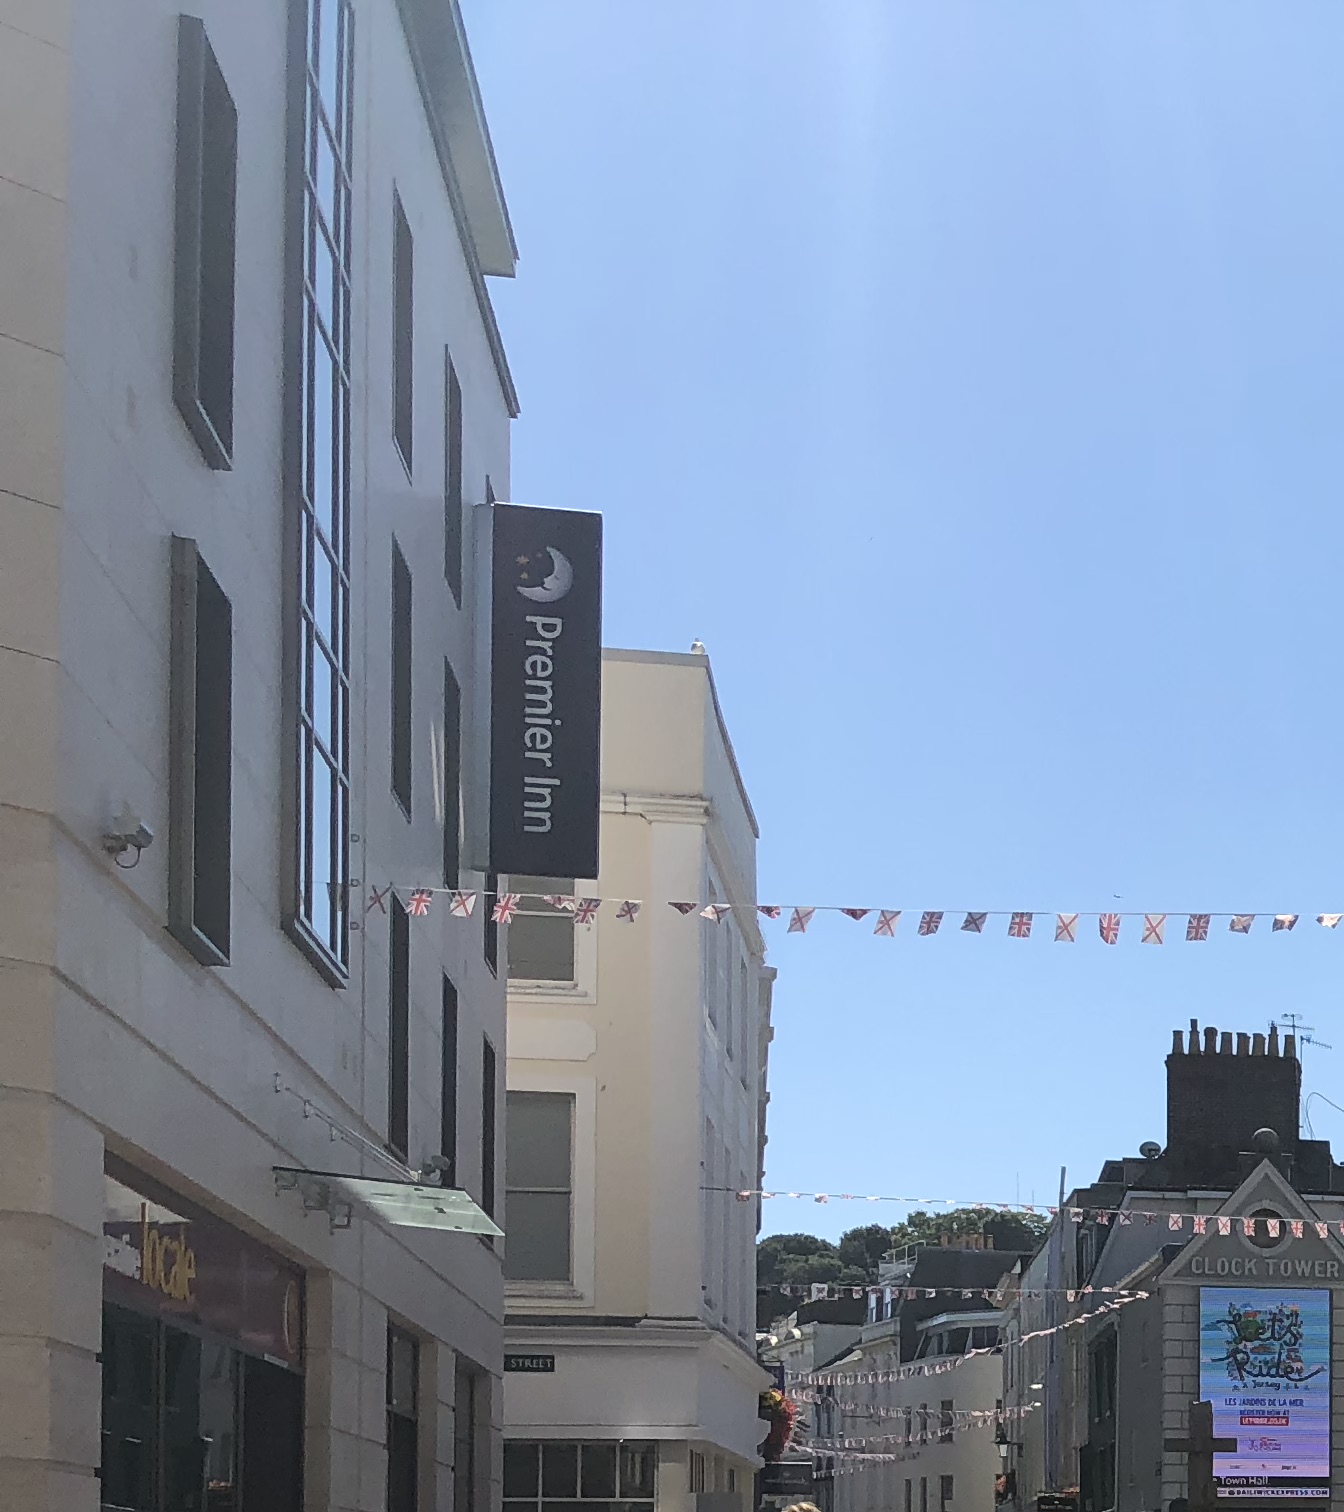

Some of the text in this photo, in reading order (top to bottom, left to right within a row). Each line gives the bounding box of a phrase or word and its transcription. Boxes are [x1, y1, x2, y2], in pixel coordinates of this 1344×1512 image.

[523, 615, 563, 833] Premier Inn
[1191, 1256, 1340, 1278] CLOCK TOWER
[511, 1358, 553, 1368] STREET
[1210, 1343, 1328, 1383] Ride
[1224, 1398, 1237, 1406] LES
[1268, 1399, 1277, 1407] DE
[1278, 1399, 1288, 1407] LA
[1289, 1399, 1305, 1407] MER
[1220, 1476, 1247, 1485] Town
